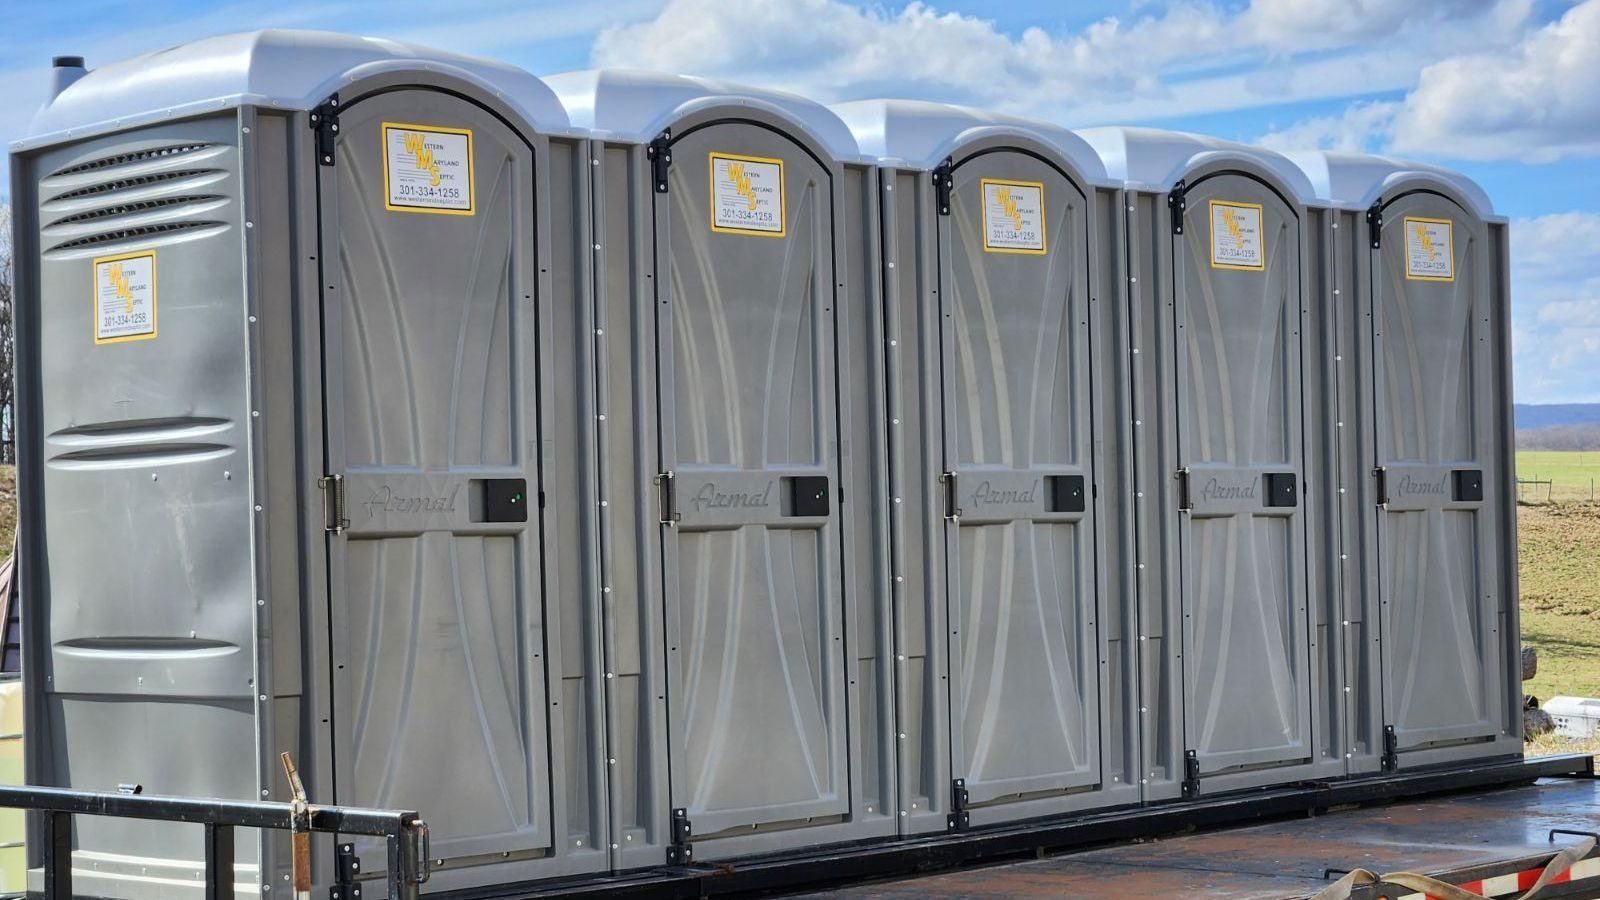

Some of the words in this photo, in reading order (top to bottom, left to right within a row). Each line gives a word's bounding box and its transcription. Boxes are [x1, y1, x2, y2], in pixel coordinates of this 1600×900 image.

[404, 132, 444, 154] WESTERN
[416, 149, 460, 169] MARYLAND
[727, 160, 760, 181] WESTERN
[399, 185, 459, 198] 301-334-1258
[736, 177, 773, 195] MARYLAND
[722, 208, 773, 222] 301-334-1258
[993, 230, 1035, 240] 301-334-1258
[109, 264, 136, 285] WESTERN
[116, 277, 147, 296] MARYLAND
[104, 312, 146, 327] 301-334-1258
[970, 480, 1038, 508] Armal
[1200, 476, 1258, 502] Armal
[1395, 473, 1447, 497] Armal
[361, 483, 461, 520] Armal
[690, 481, 773, 512] Armal
